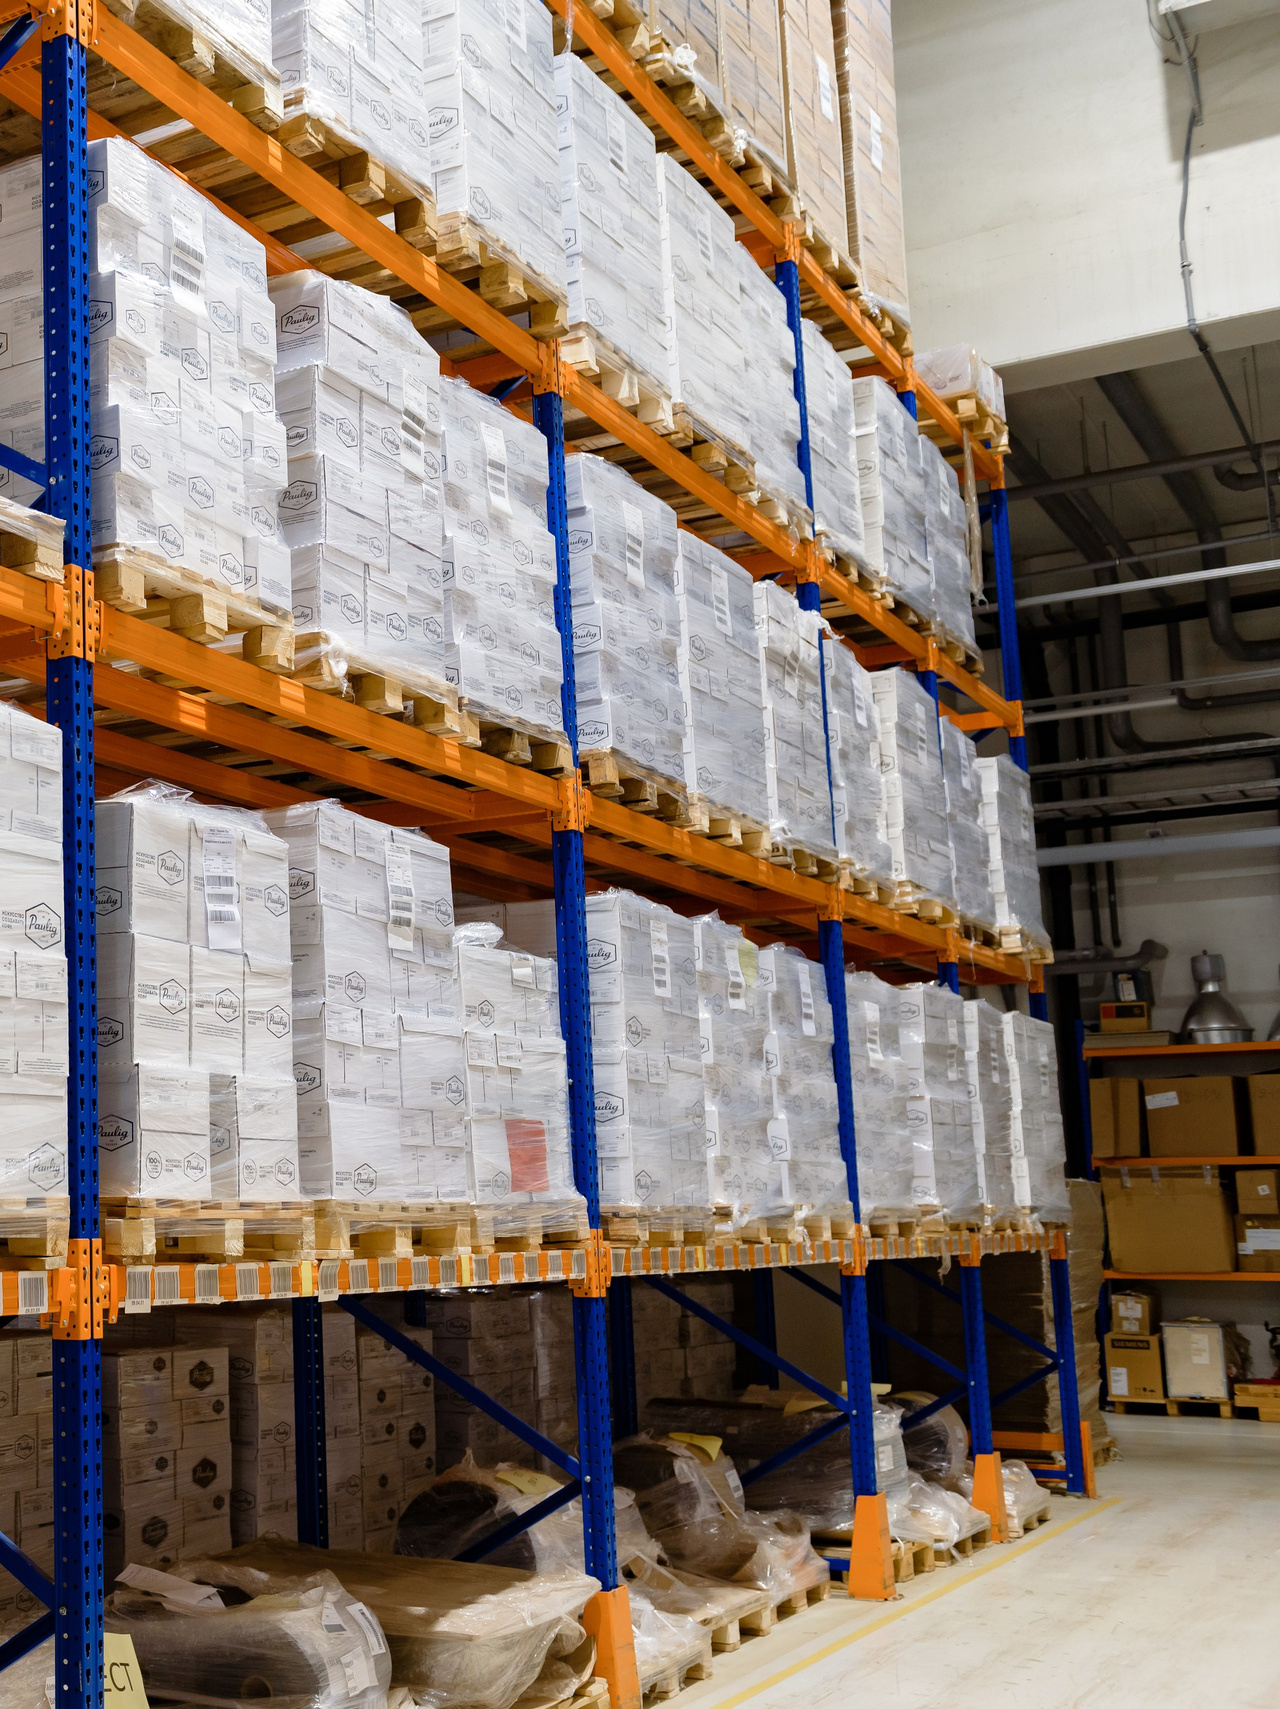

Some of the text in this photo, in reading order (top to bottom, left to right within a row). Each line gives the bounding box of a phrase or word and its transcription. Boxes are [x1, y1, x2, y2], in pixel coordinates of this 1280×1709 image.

[285, 312, 316, 326] Paulig
[282, 488, 313, 502] Paulig
[160, 859, 181, 877] Paulig
[30, 916, 58, 938] Paulig
[163, 988, 183, 1006] Paulig
[269, 1015, 288, 1029] Paulig
